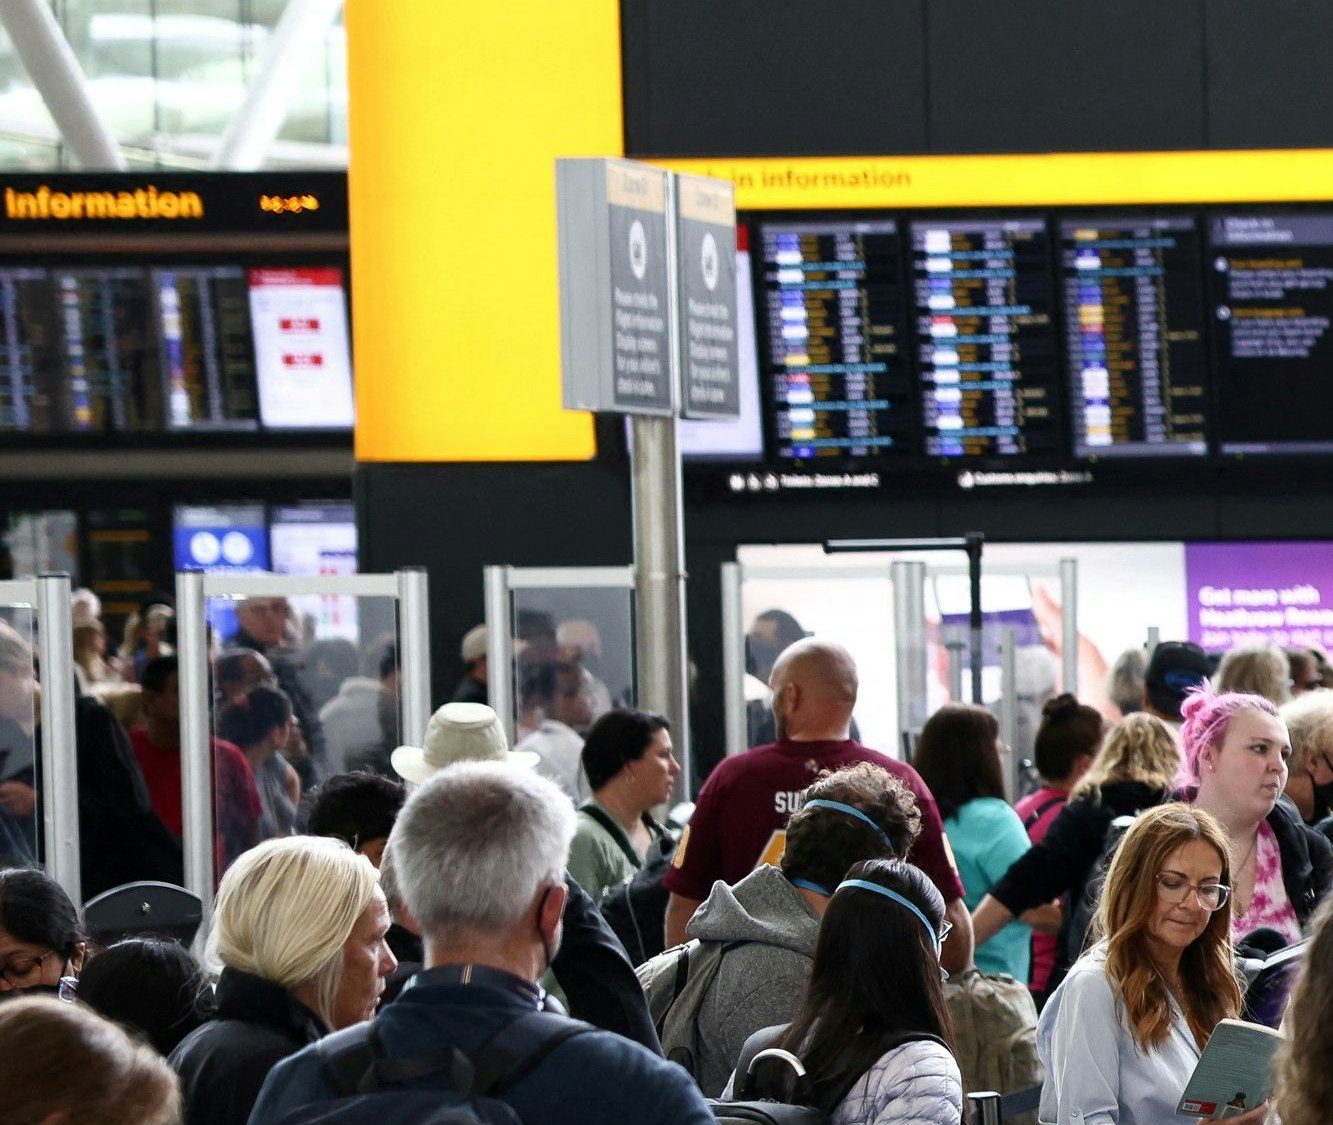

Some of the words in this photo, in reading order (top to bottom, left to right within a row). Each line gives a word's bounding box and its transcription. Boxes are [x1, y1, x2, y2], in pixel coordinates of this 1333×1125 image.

[761, 165, 912, 189] information
[5, 175, 204, 219] Information
[1198, 586, 1231, 606] Get
[1232, 589, 1278, 606] more
[1279, 584, 1320, 605] with
[775, 791, 801, 813] SU
